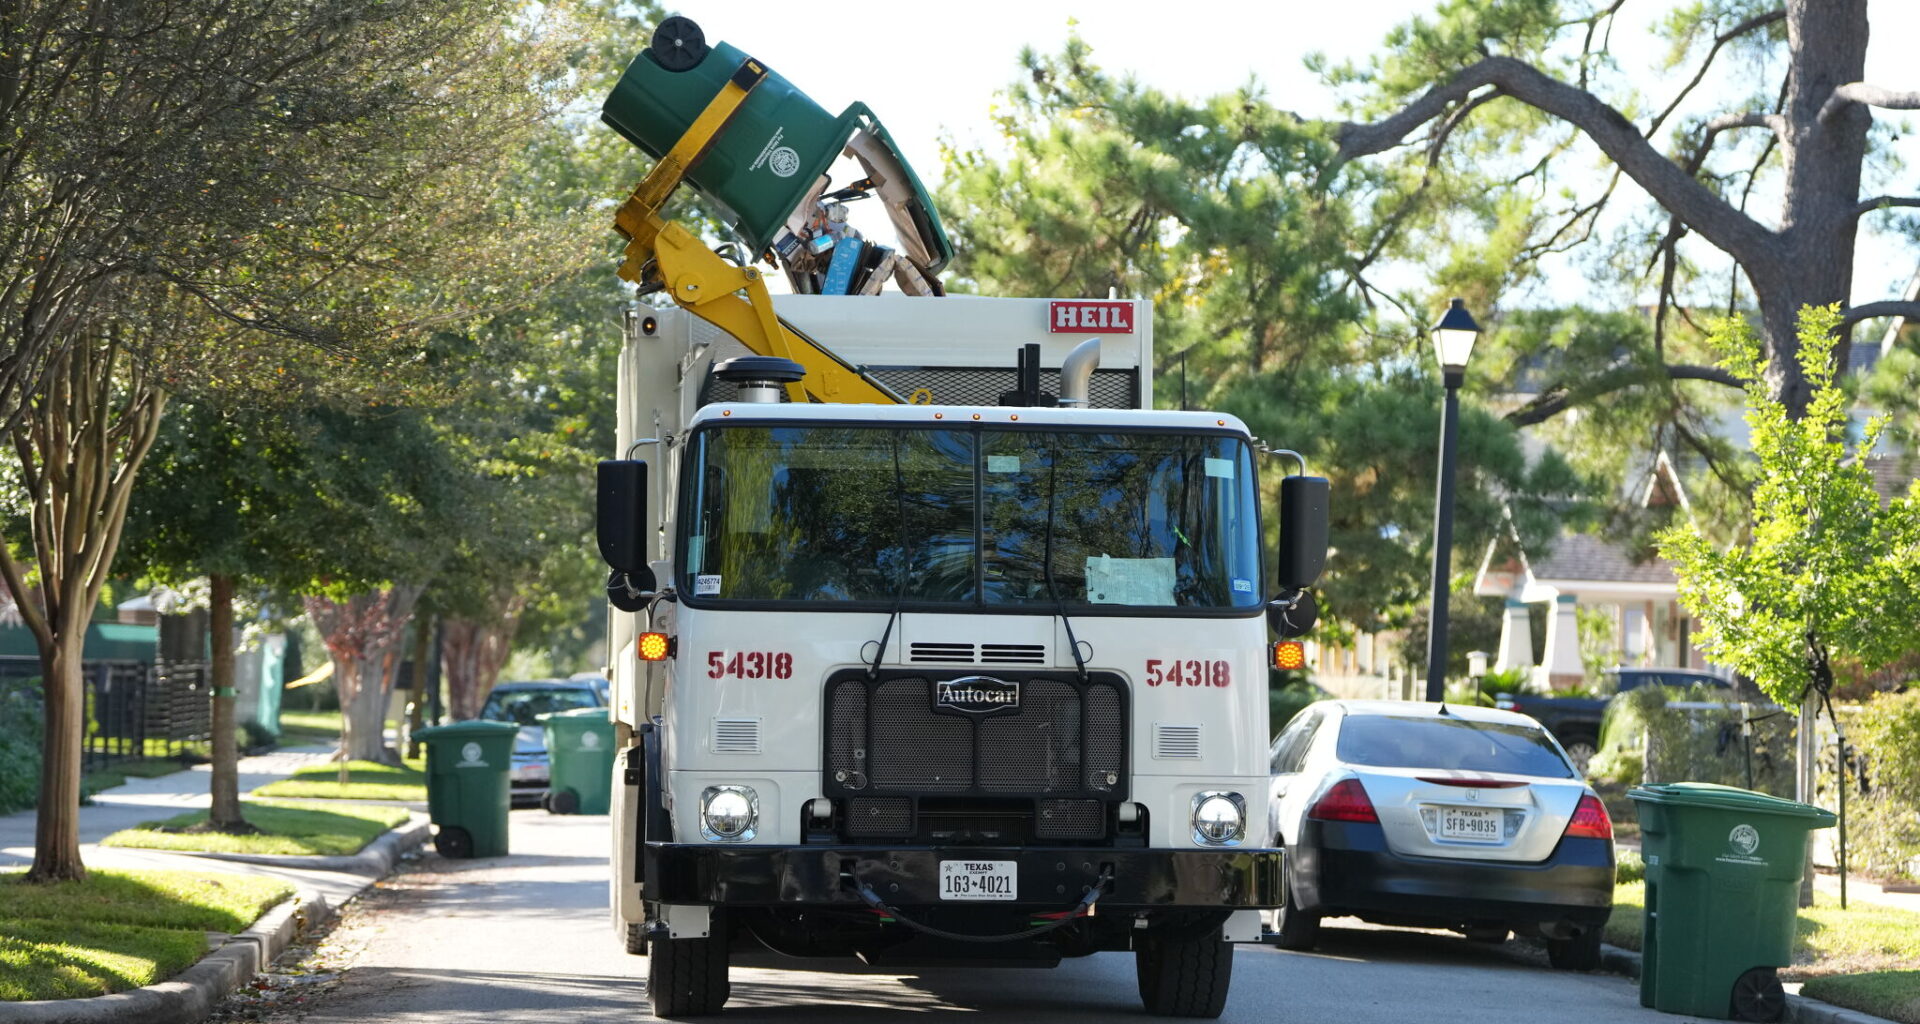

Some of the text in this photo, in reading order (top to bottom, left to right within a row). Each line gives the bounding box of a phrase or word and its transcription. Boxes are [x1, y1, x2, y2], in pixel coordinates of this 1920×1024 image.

[1056, 306, 1128, 328] HEIL
[707, 651, 793, 679] 54318
[1146, 659, 1231, 688] 54318
[940, 684, 1015, 703] Autocar
[964, 863, 993, 871] TEXAS
